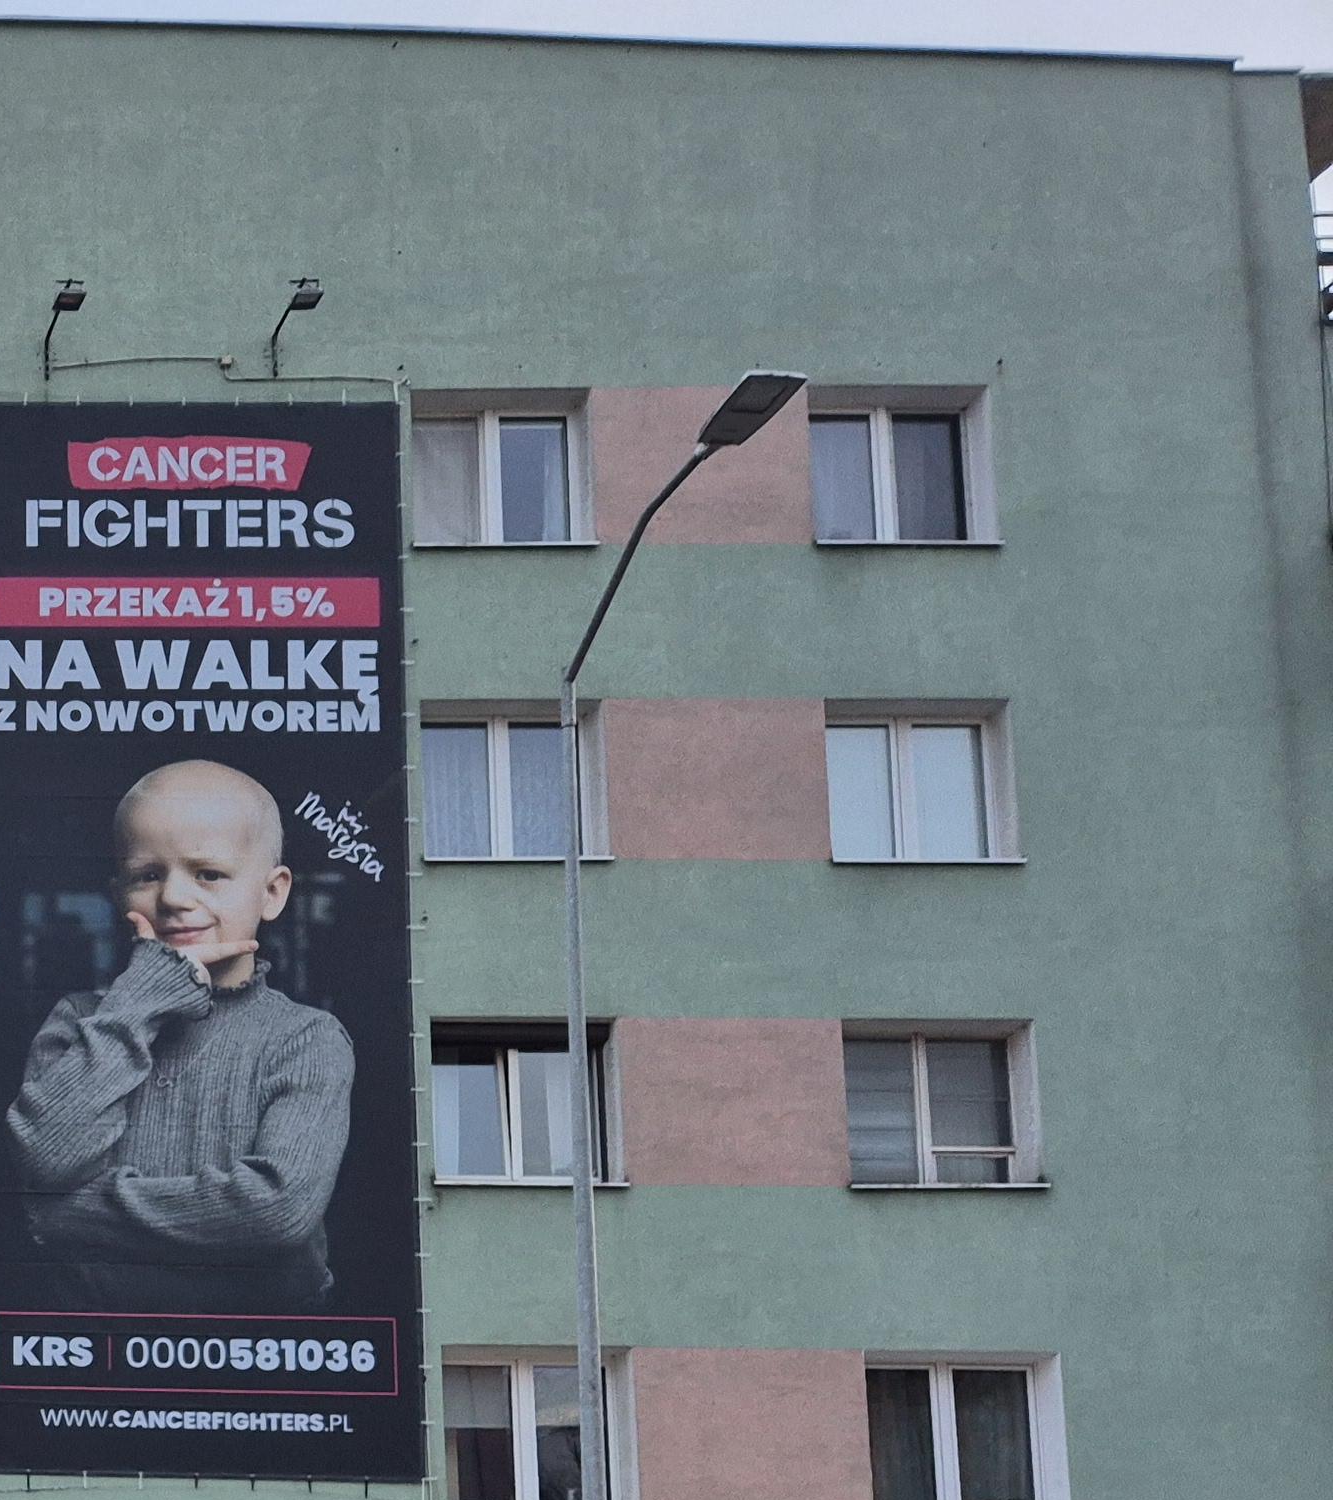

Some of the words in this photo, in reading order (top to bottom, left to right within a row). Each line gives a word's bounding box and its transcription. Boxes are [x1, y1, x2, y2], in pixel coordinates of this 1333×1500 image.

[87, 446, 287, 482] CANCER
[25, 498, 355, 548] FIGHTERS
[38, 578, 231, 618] PRZEKAŻ
[237, 586, 335, 622] 1,5%
[115, 639, 380, 706] WALKĘ
[26, 699, 381, 732] NOWOTWOREM
[11, 1335, 94, 1368] KRS
[125, 1336, 376, 1373] 0000581036
[39, 1408, 354, 1434] WWW.CANCERFIGHTERS.PL
